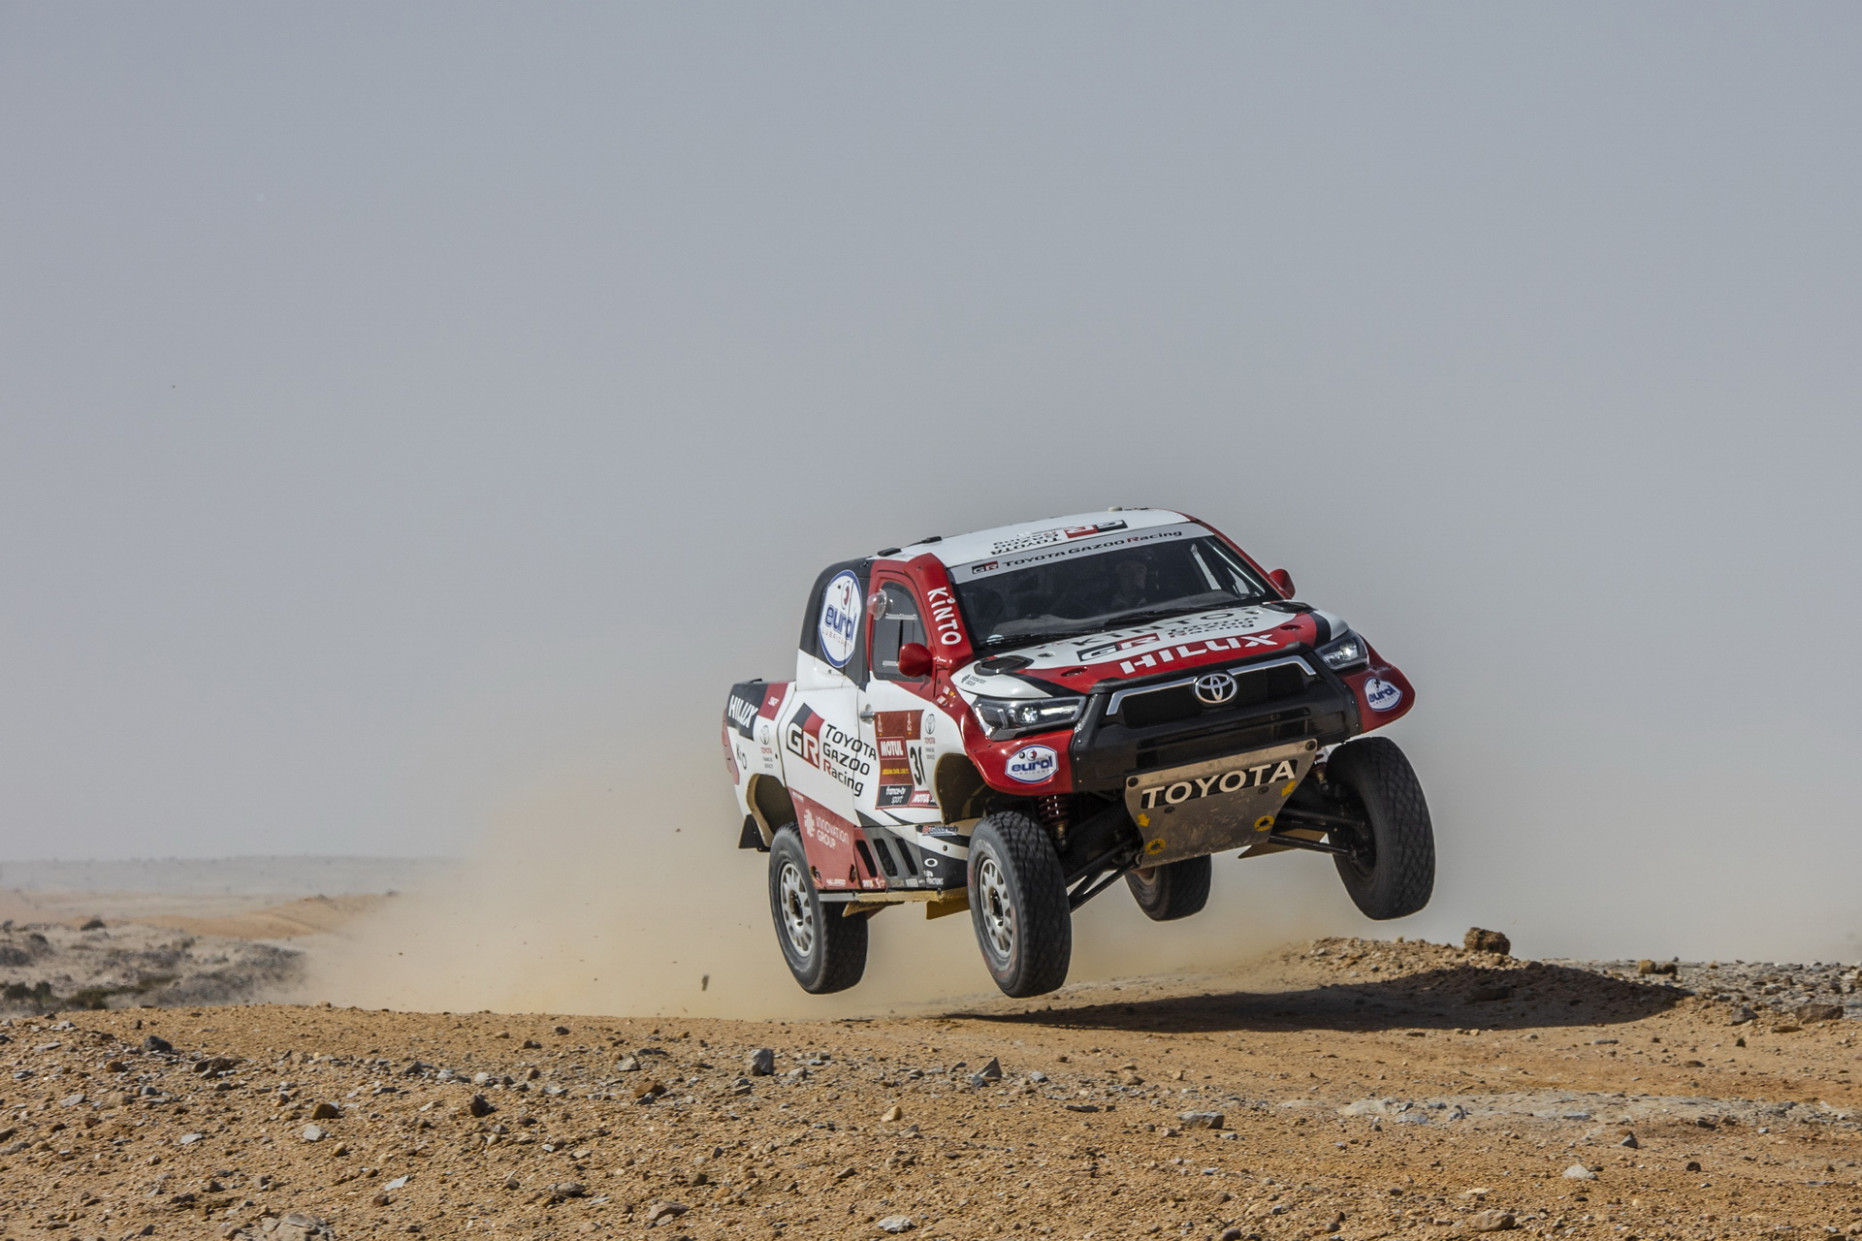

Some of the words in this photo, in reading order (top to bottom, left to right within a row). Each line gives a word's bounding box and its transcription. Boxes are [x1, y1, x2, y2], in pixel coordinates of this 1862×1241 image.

[972, 561, 998, 574] GR
[1002, 551, 1067, 567] TOYOTA
[1068, 539, 1125, 555] GAZOO
[1127, 531, 1183, 543] Racing
[825, 604, 857, 643] eurol
[1077, 633, 1160, 661] GR
[1120, 634, 1278, 674] HILUX
[728, 695, 759, 728] HILUX
[787, 722, 820, 769] GR
[822, 742, 871, 776] GAZOO
[826, 724, 877, 761] TOYOTA
[881, 740, 904, 757] MOTUL
[823, 759, 865, 797] Racing
[1011, 755, 1053, 772] eurol
[1142, 760, 1296, 809] TOYOTA
[815, 815, 850, 846] INNOVATION
[816, 829, 836, 850] GROUP
